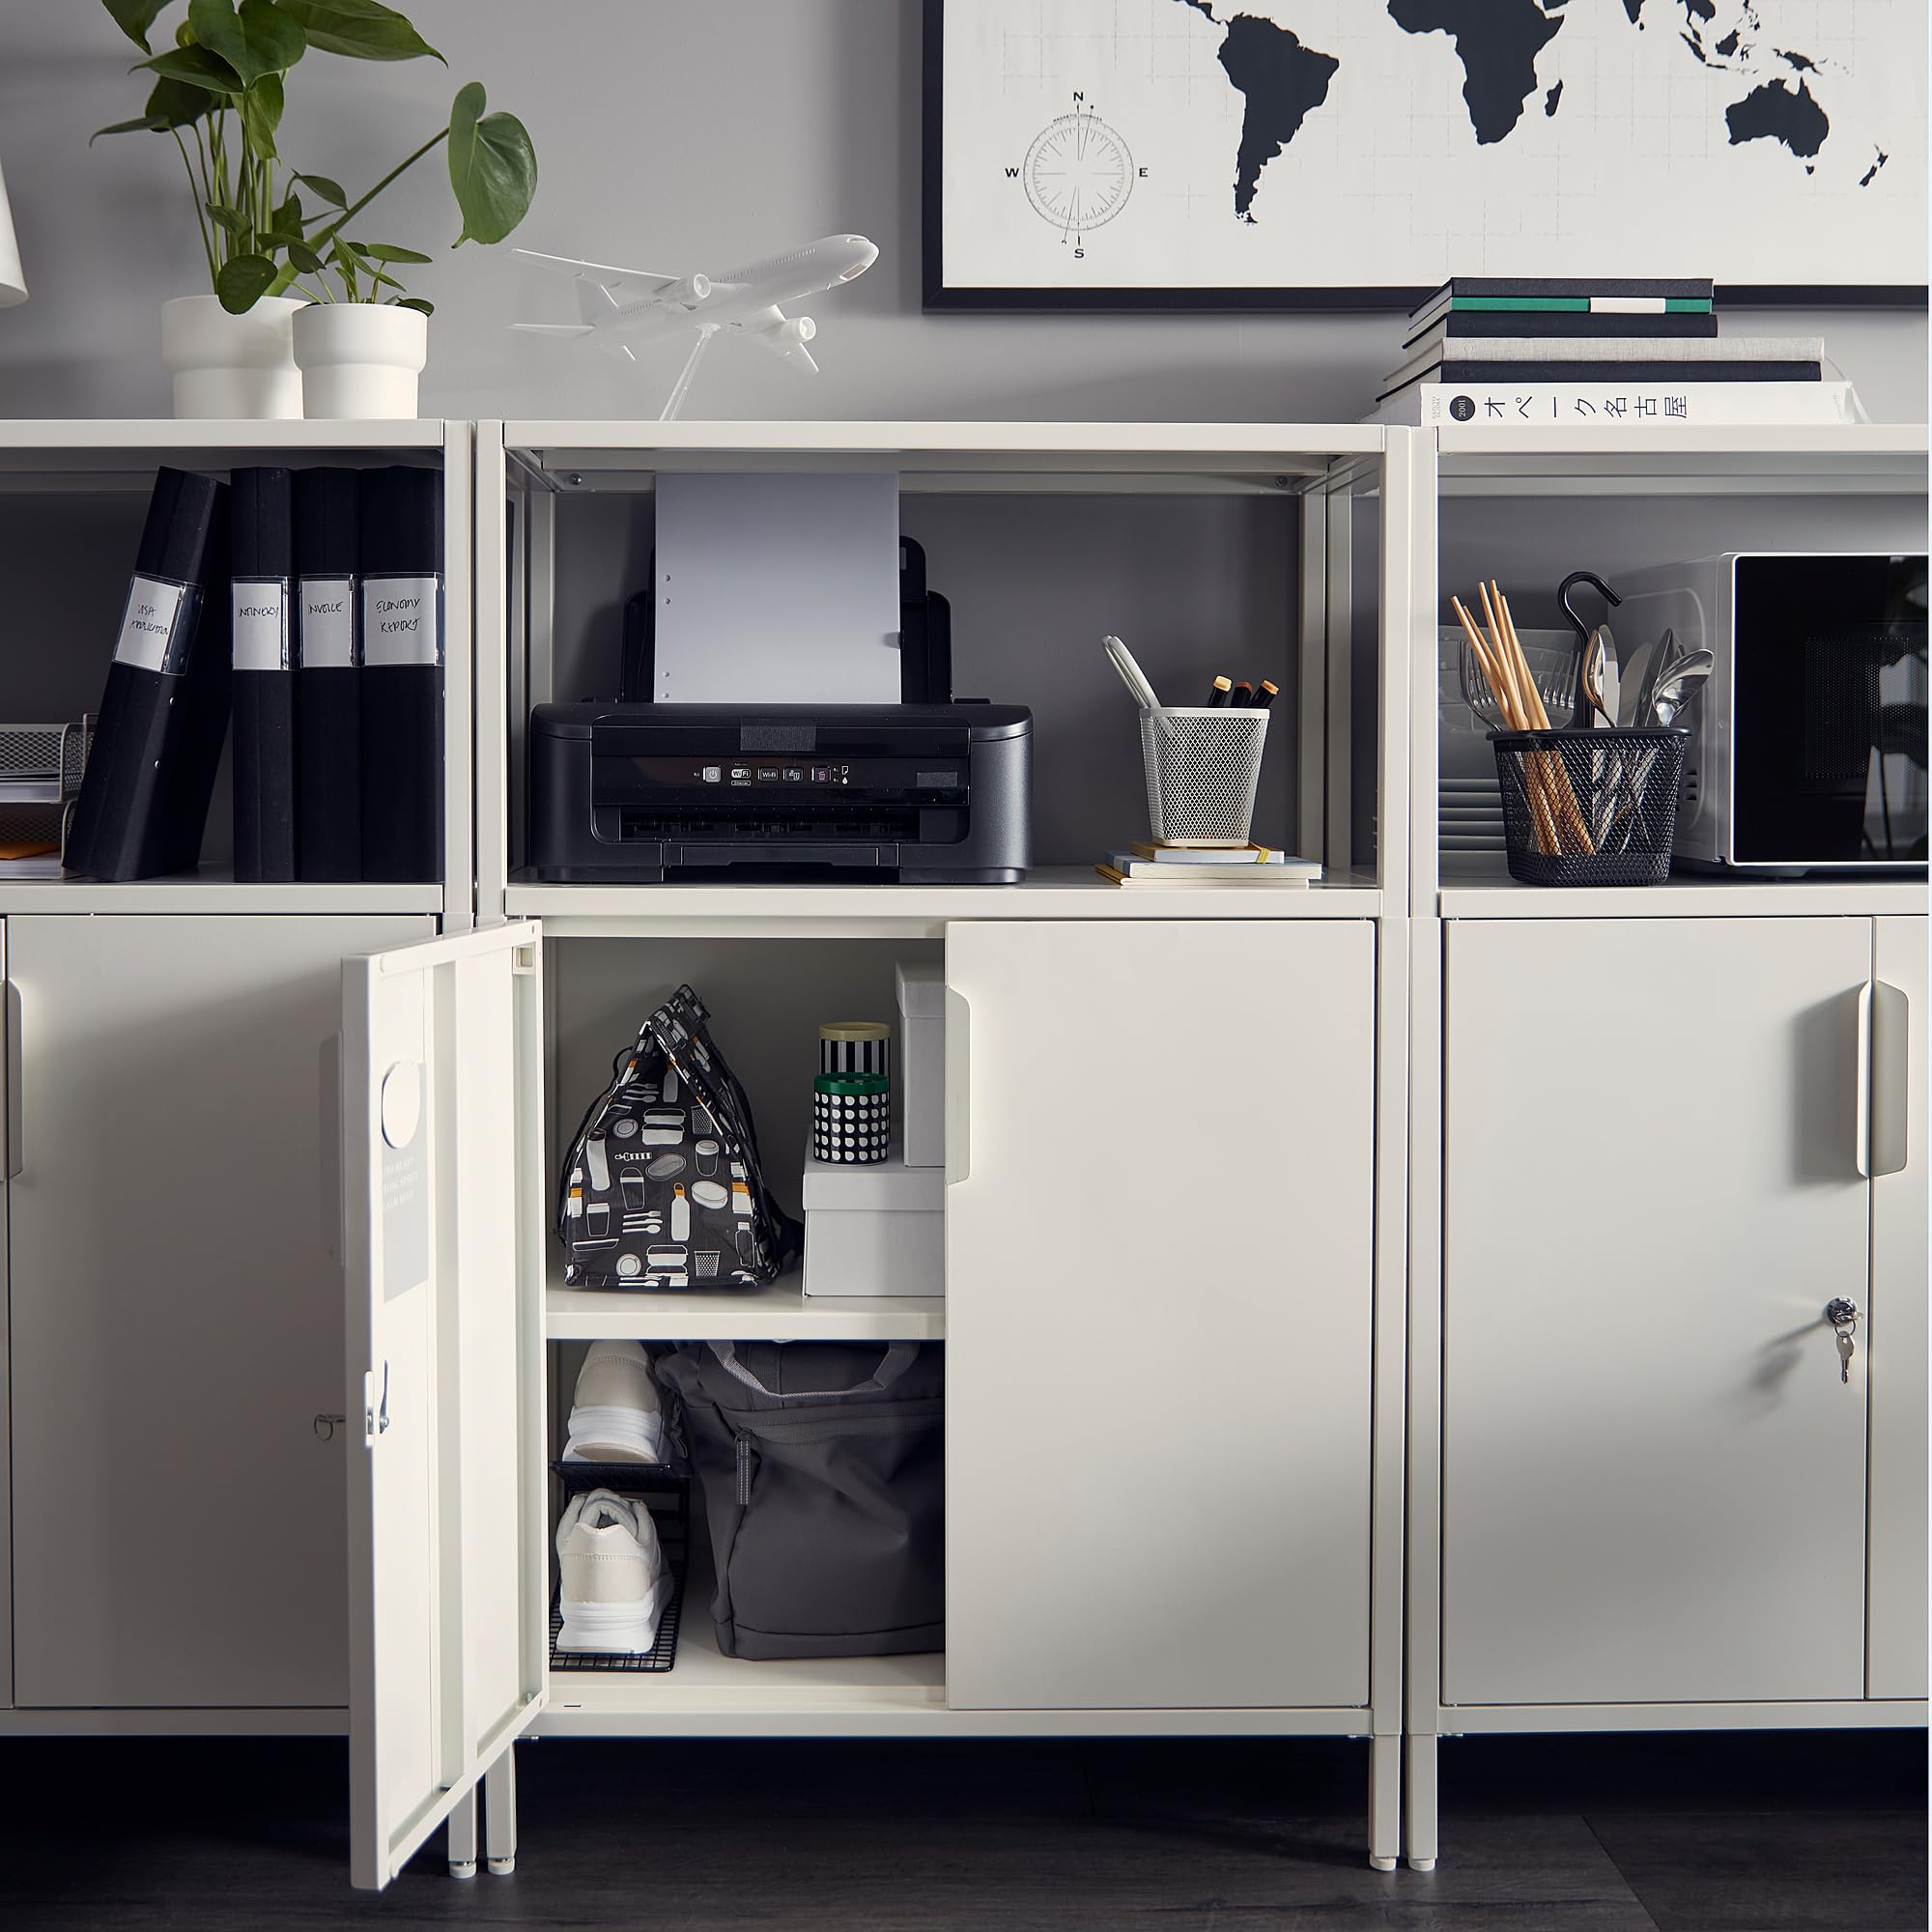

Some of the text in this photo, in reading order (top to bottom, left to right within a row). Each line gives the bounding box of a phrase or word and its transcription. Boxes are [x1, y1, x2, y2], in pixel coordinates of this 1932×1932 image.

[1073, 92, 1084, 101] N
[1005, 168, 1019, 178] W
[1139, 167, 1149, 177] E
[1074, 248, 1085, 258] S
[1458, 400, 1466, 417] 2001
[375, 598, 421, 613] ECONOMY
